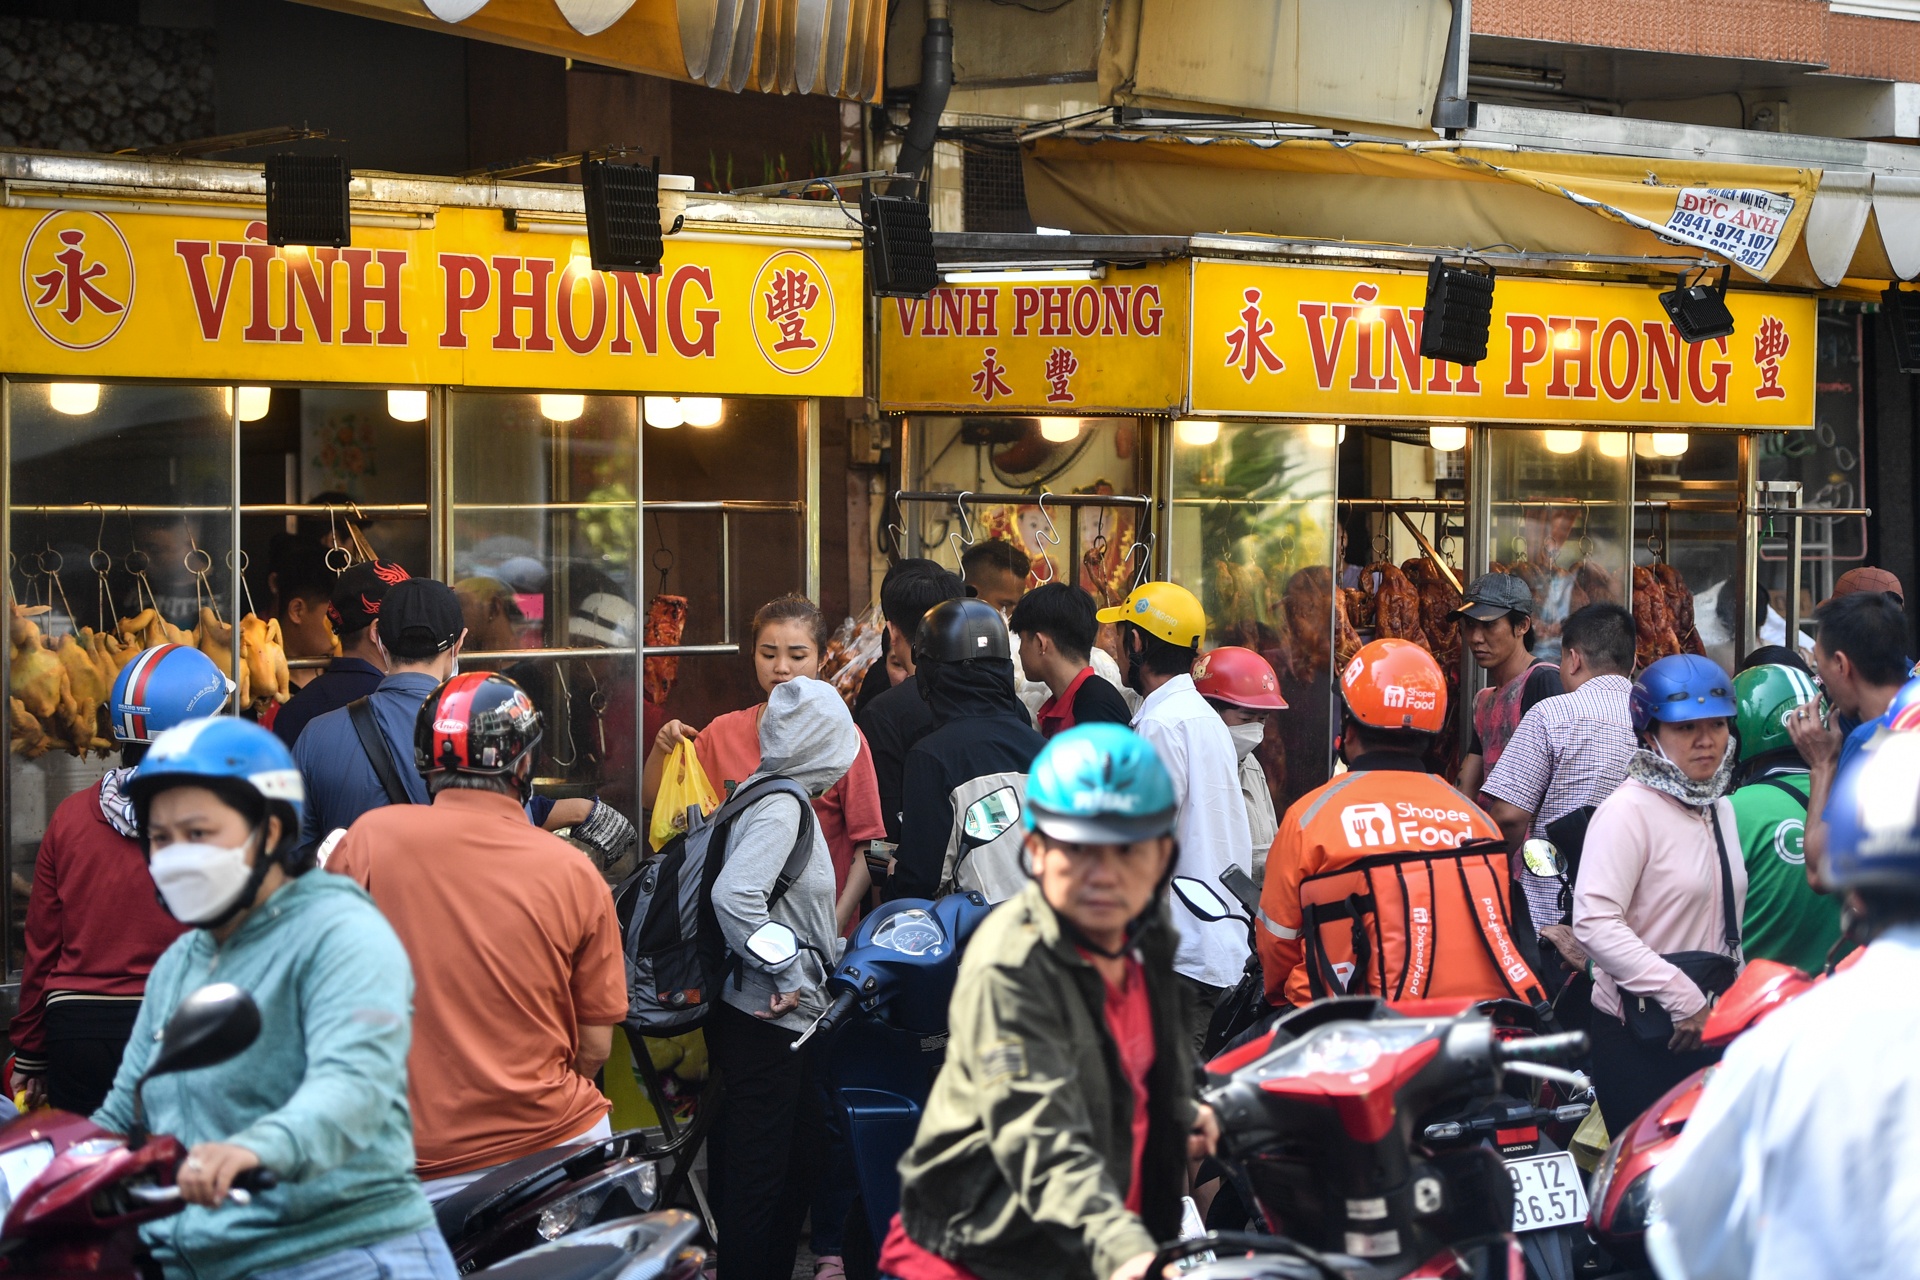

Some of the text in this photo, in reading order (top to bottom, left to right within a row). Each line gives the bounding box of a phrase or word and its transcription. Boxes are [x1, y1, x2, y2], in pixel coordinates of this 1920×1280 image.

[1682, 193, 1728, 219] ĐỨC
[1672, 211, 1775, 250] 0941.974.107
[34, 229, 126, 325] 永
[438, 253, 720, 359] PHONG
[1012, 284, 1164, 338] PHONG
[1225, 286, 1286, 384] 永
[972, 347, 1013, 403] 永
[1504, 312, 1733, 406] PHONG
[1149, 606, 1178, 627] PIAGGIO
[1405, 697, 1436, 710] Food
[1407, 687, 1436, 700] Shopee
[1396, 802, 1471, 823] Shopee
[1399, 821, 1473, 848] Food
[1481, 897, 1516, 967] ShopeeFood
[1502, 1144, 1534, 1153] HONDA
